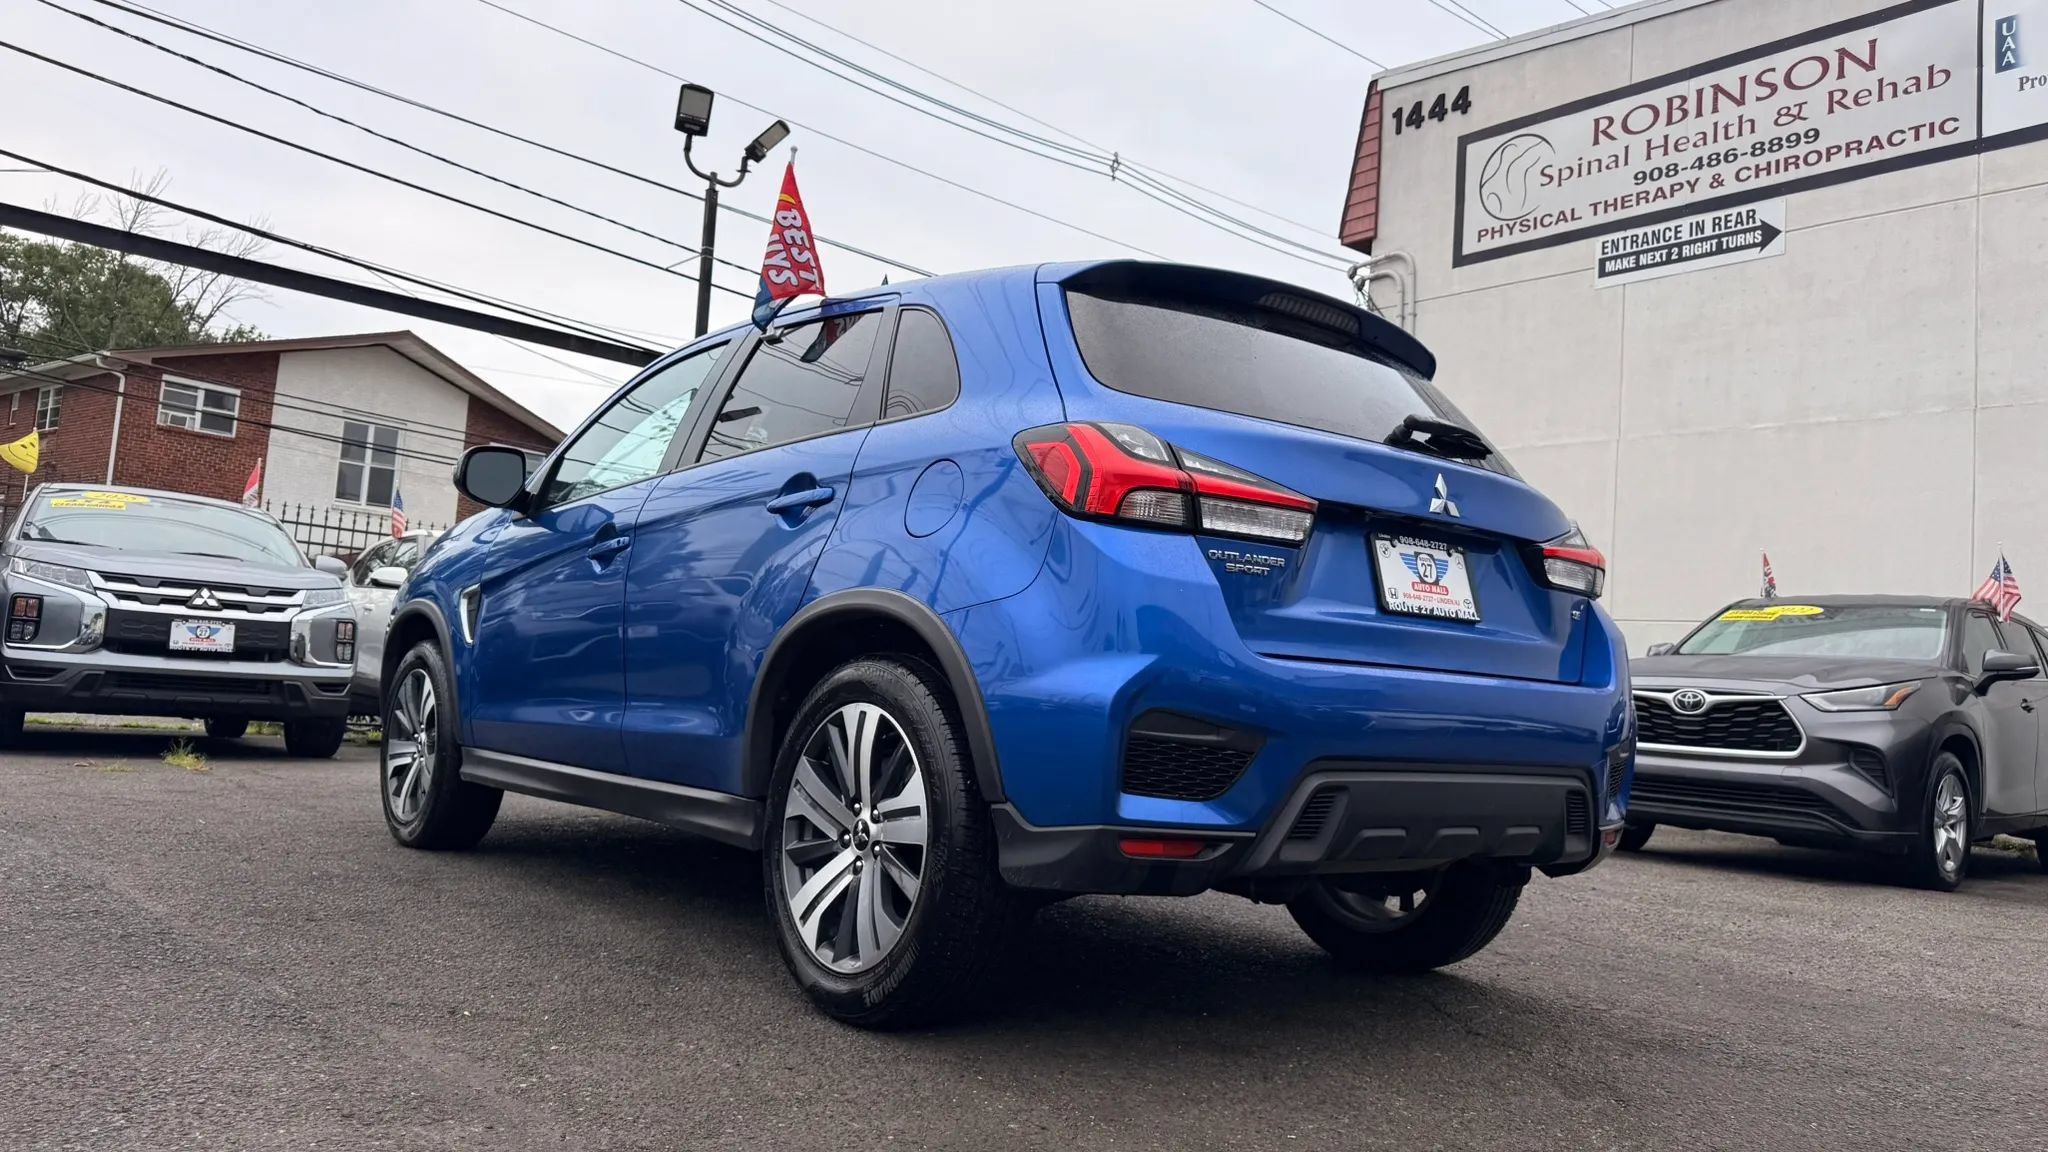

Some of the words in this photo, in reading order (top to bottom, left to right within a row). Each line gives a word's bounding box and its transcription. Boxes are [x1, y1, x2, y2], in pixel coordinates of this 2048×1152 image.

[1592, 38, 1878, 146] ROBINSON
[2018, 75, 2048, 92] Pro
[1392, 86, 1471, 135] 1444
[1540, 145, 1629, 187] Spinal
[1645, 114, 1756, 161] Health
[1773, 101, 1808, 127] &
[1827, 64, 1951, 115] Rehab
[1633, 128, 1820, 186] 908-486-8899
[1477, 208, 1582, 243] PHYSICAL
[1589, 177, 1701, 217] THERAPY
[1709, 173, 1725, 189] &
[1734, 117, 1960, 183] CHIROPRACTIC
[776, 208, 820, 288] BEST
[1601, 225, 1683, 256] ENTRANCE
[1689, 219, 1705, 237] IN
[1712, 209, 1757, 232] REAR
[1605, 255, 1636, 273] MAKE
[1639, 249, 1668, 267] NEXT
[1671, 247, 1679, 260] 2
[1682, 240, 1718, 258] RIGHT
[1721, 230, 1763, 251] TURNS
[1208, 549, 1285, 567] OUTLANDER
[1399, 535, 1447, 550] 908-648-2727
[1225, 563, 1271, 576] SPORT
[1414, 583, 1430, 592] AUTO
[1431, 585, 1447, 595] MALL
[1421, 561, 1433, 579] 27
[1388, 602, 1419, 612] ROUTE
[1421, 605, 1432, 614] 27
[1433, 607, 1456, 618] AUTO
[1457, 610, 1480, 620] MALL
